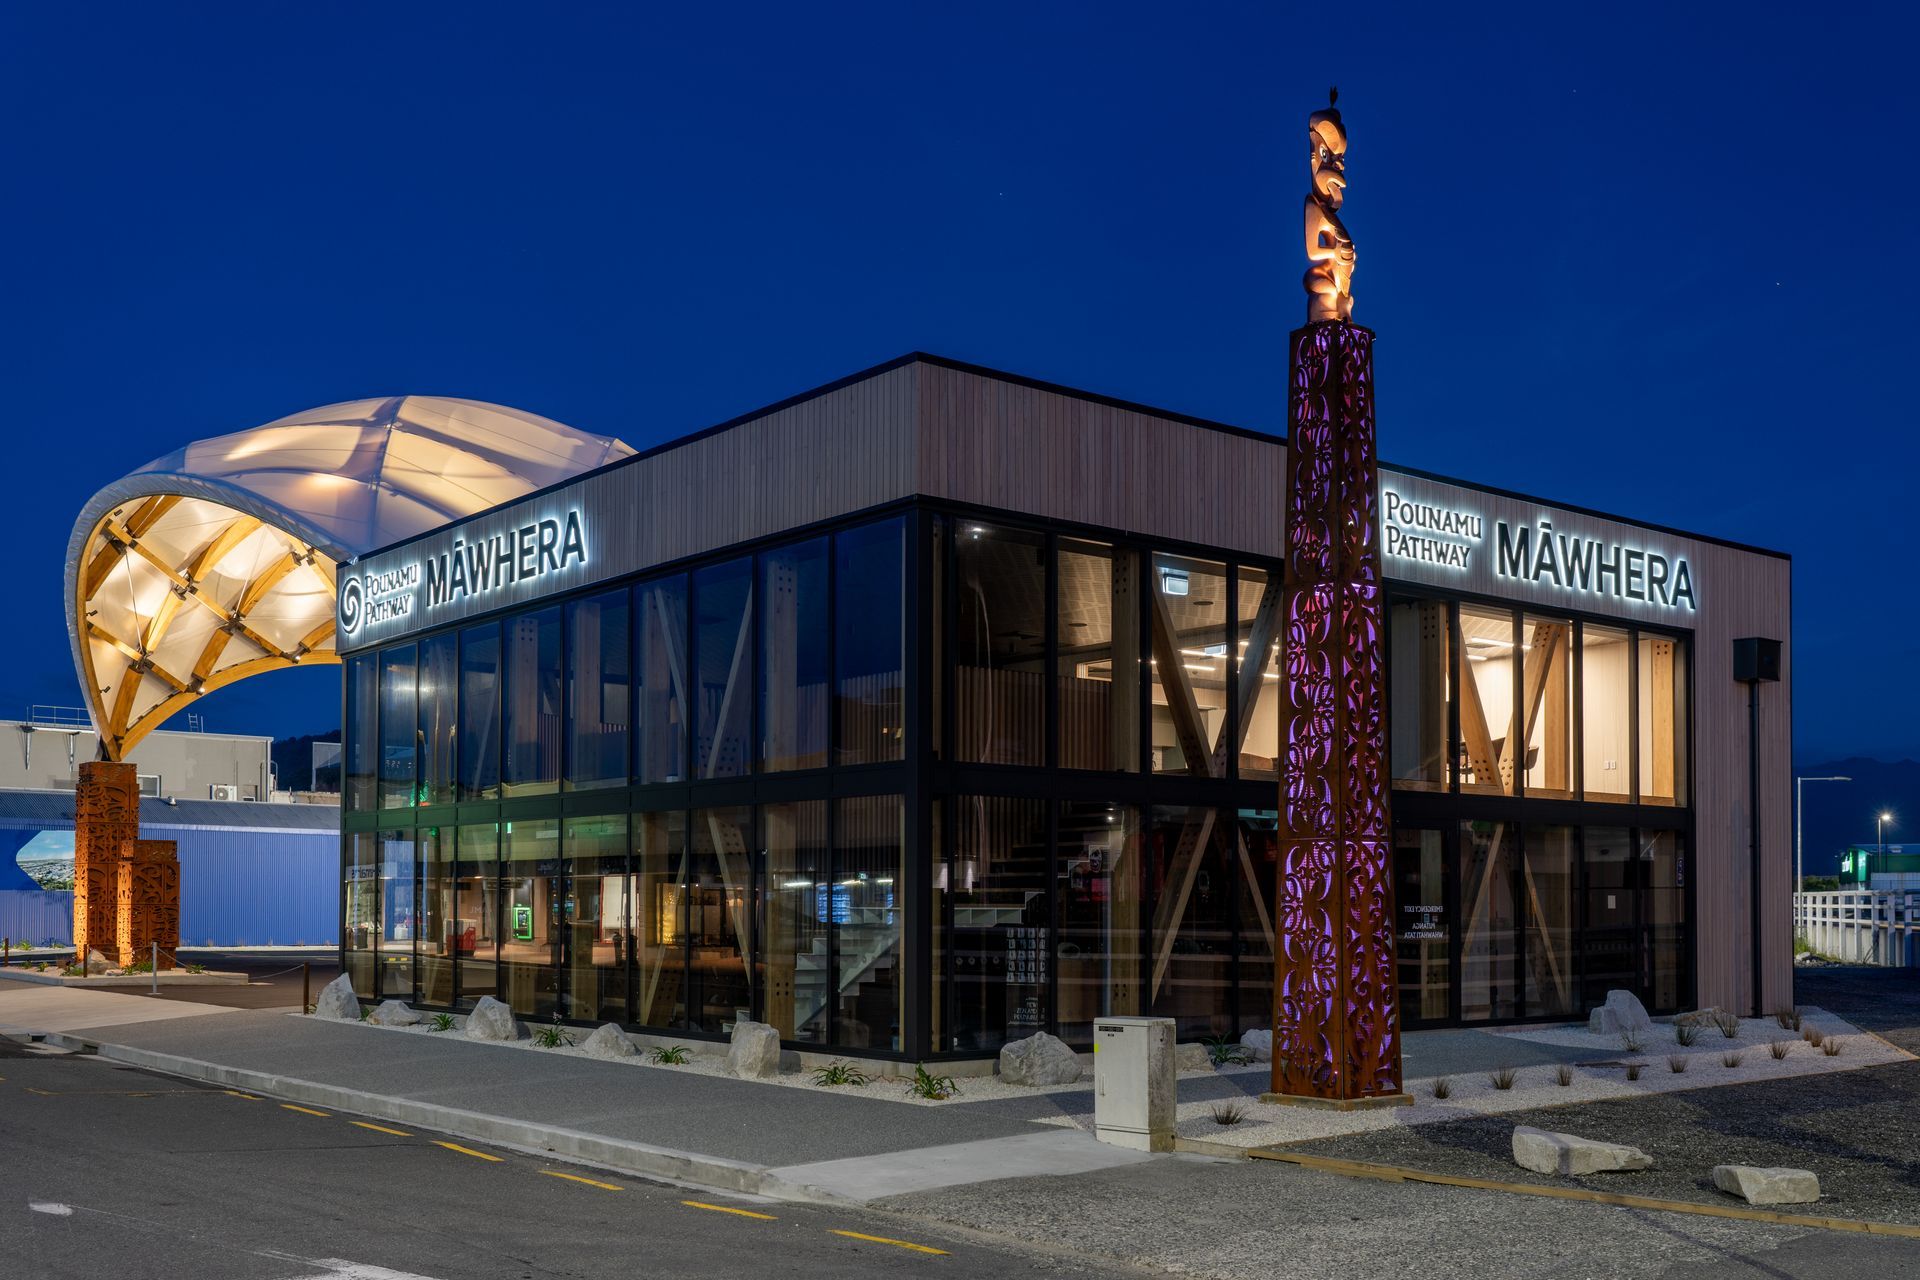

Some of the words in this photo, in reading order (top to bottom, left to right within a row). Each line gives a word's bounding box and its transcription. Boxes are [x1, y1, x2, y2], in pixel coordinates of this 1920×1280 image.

[1384, 491, 1482, 539] POUNAMU
[426, 510, 586, 607] MĀWHERA
[1385, 525, 1470, 568] PATHWAY
[1497, 521, 1696, 610] MĀWHERA
[364, 594, 411, 625] PATHWAY
